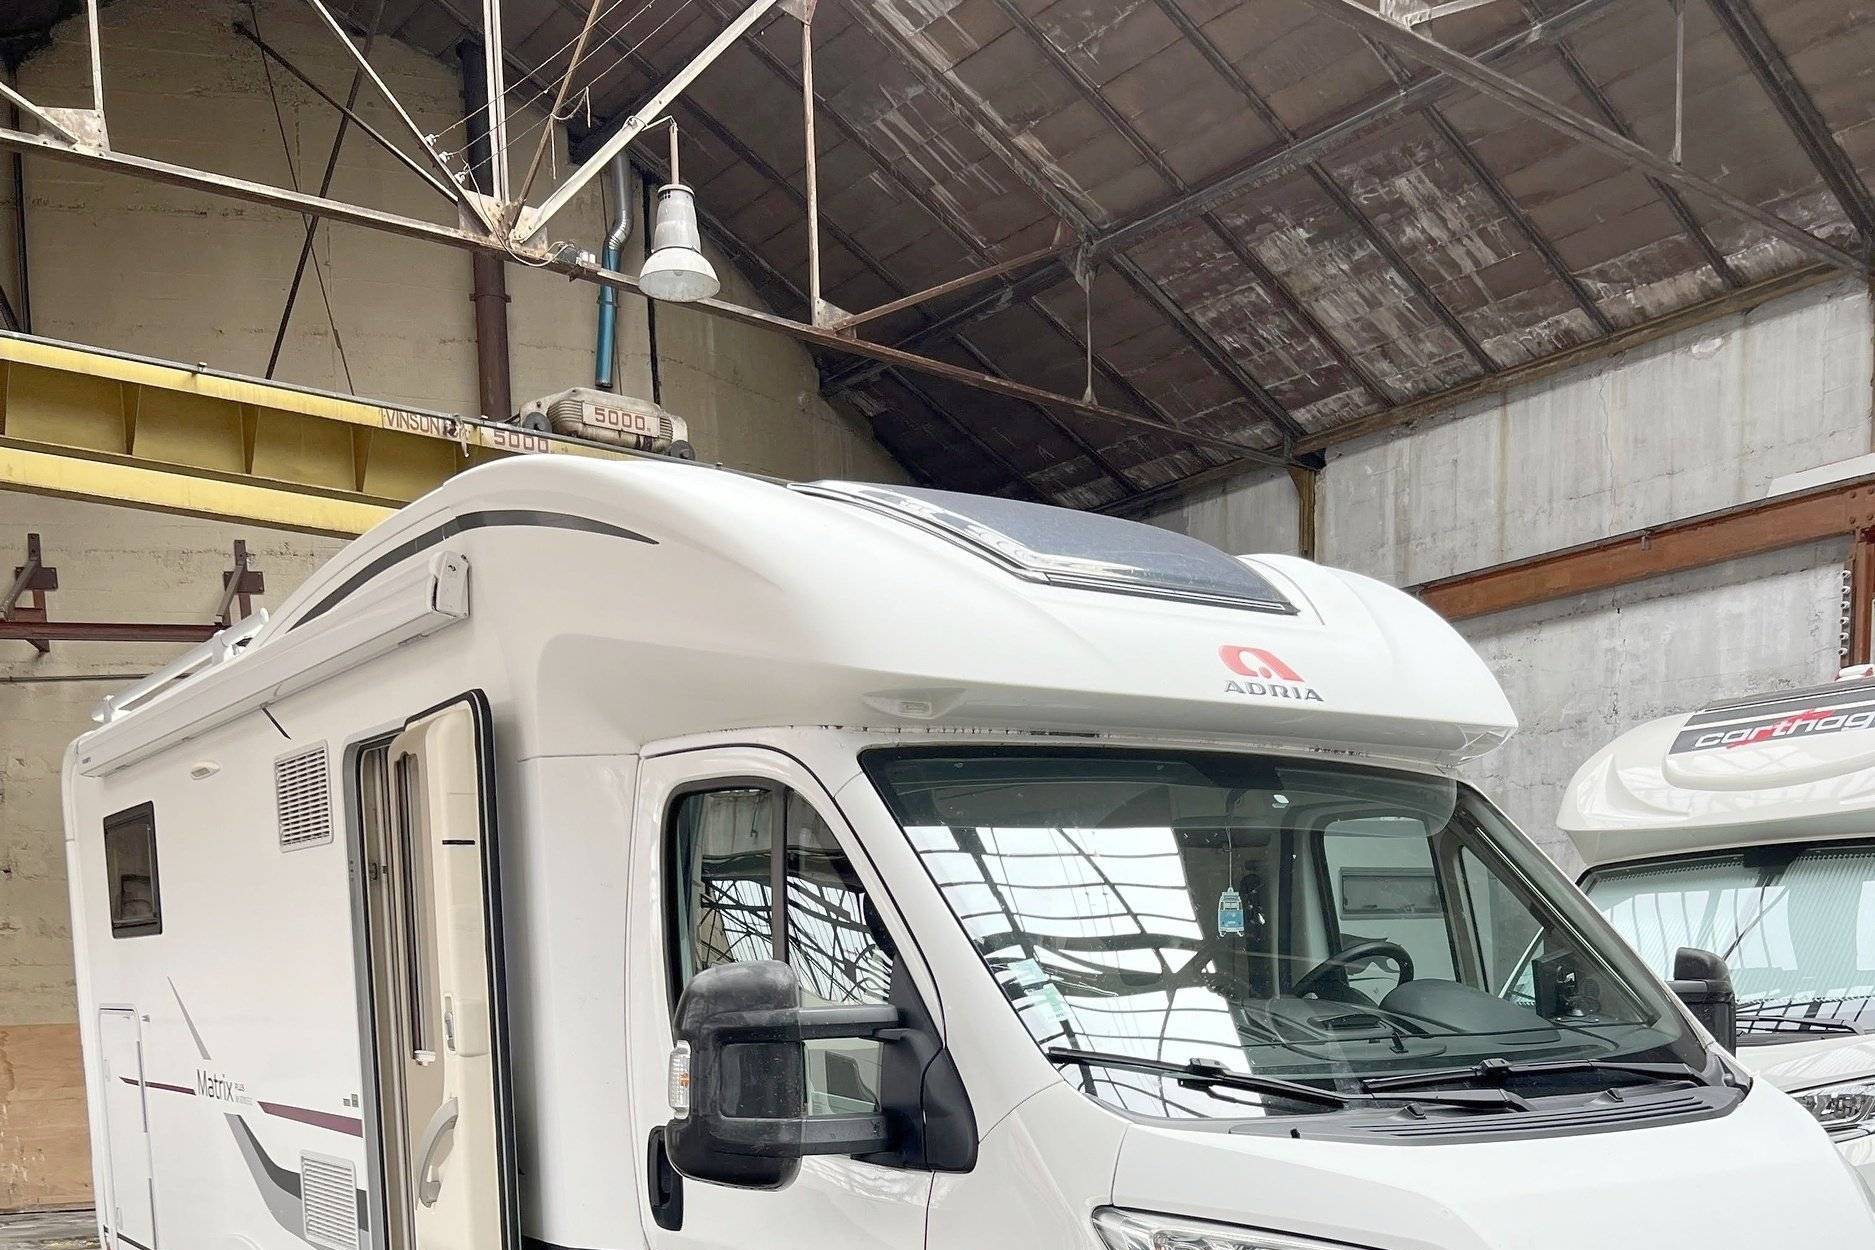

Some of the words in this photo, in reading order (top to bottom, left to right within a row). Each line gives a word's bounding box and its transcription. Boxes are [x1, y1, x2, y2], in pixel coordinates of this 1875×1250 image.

[493, 430, 549, 454] 5000
[1225, 680, 1324, 702] ADRIA
[196, 1069, 234, 1102] Matrix
